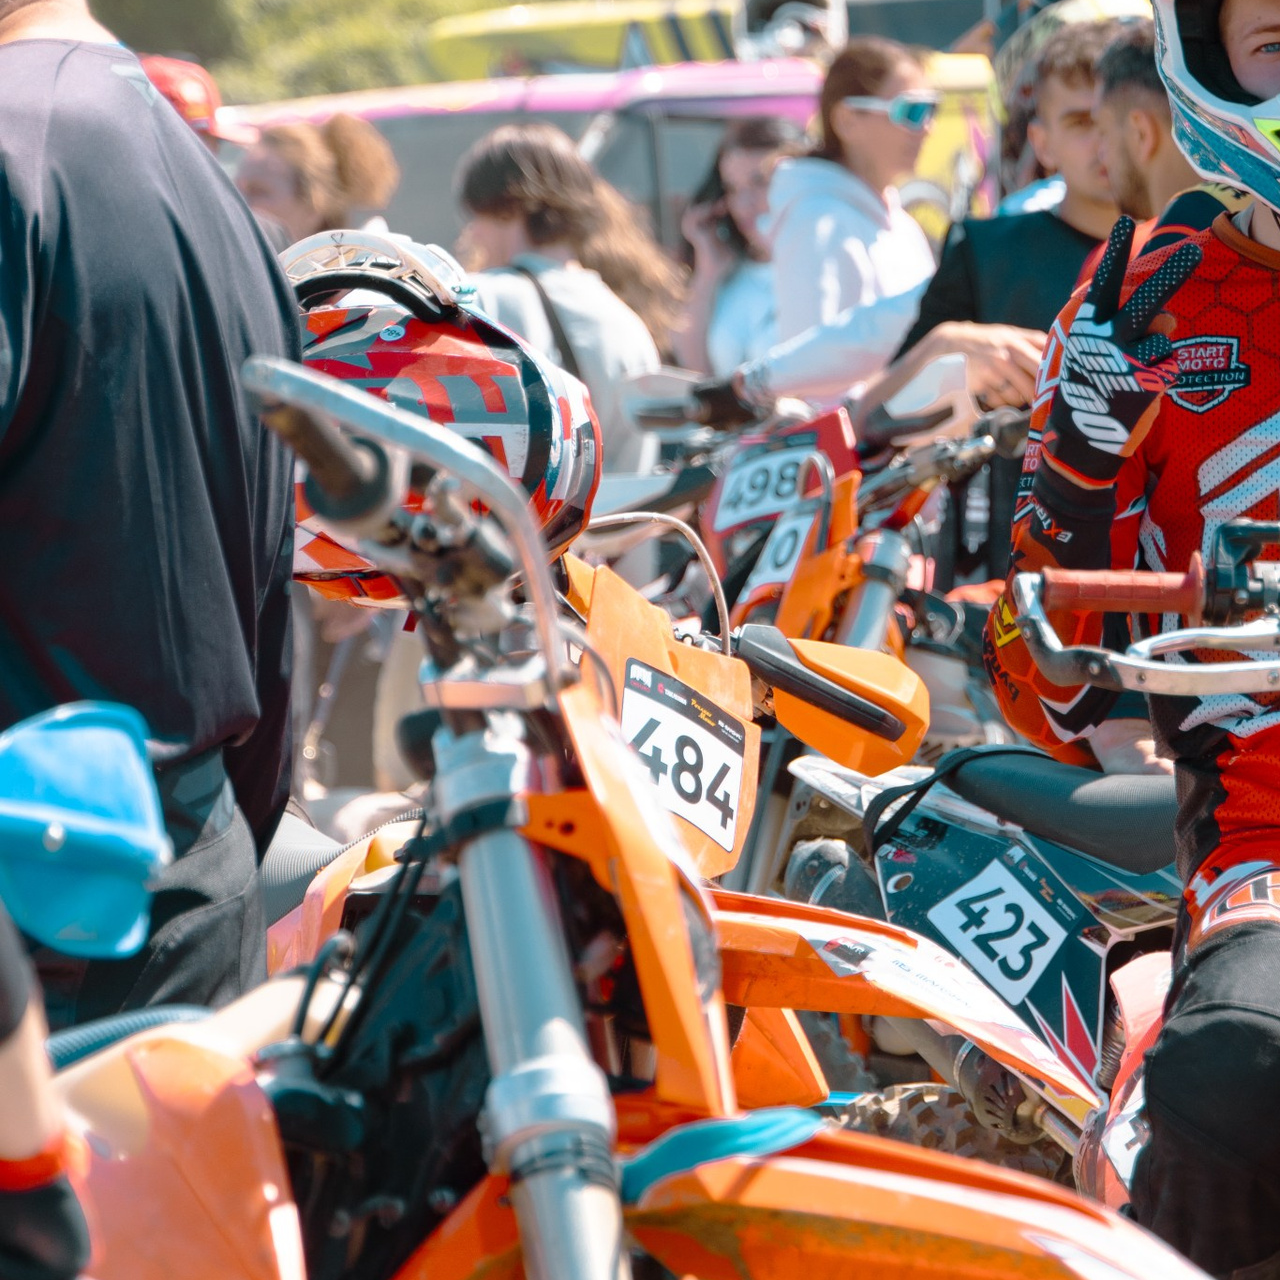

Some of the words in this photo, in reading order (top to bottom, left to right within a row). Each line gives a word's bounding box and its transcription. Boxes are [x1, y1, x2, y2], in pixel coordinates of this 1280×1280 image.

[1177, 345, 1227, 360] START
[1177, 357, 1226, 371] MOTO
[721, 461, 802, 511] 498
[629, 716, 736, 831] 484
[954, 886, 1050, 982] 423
